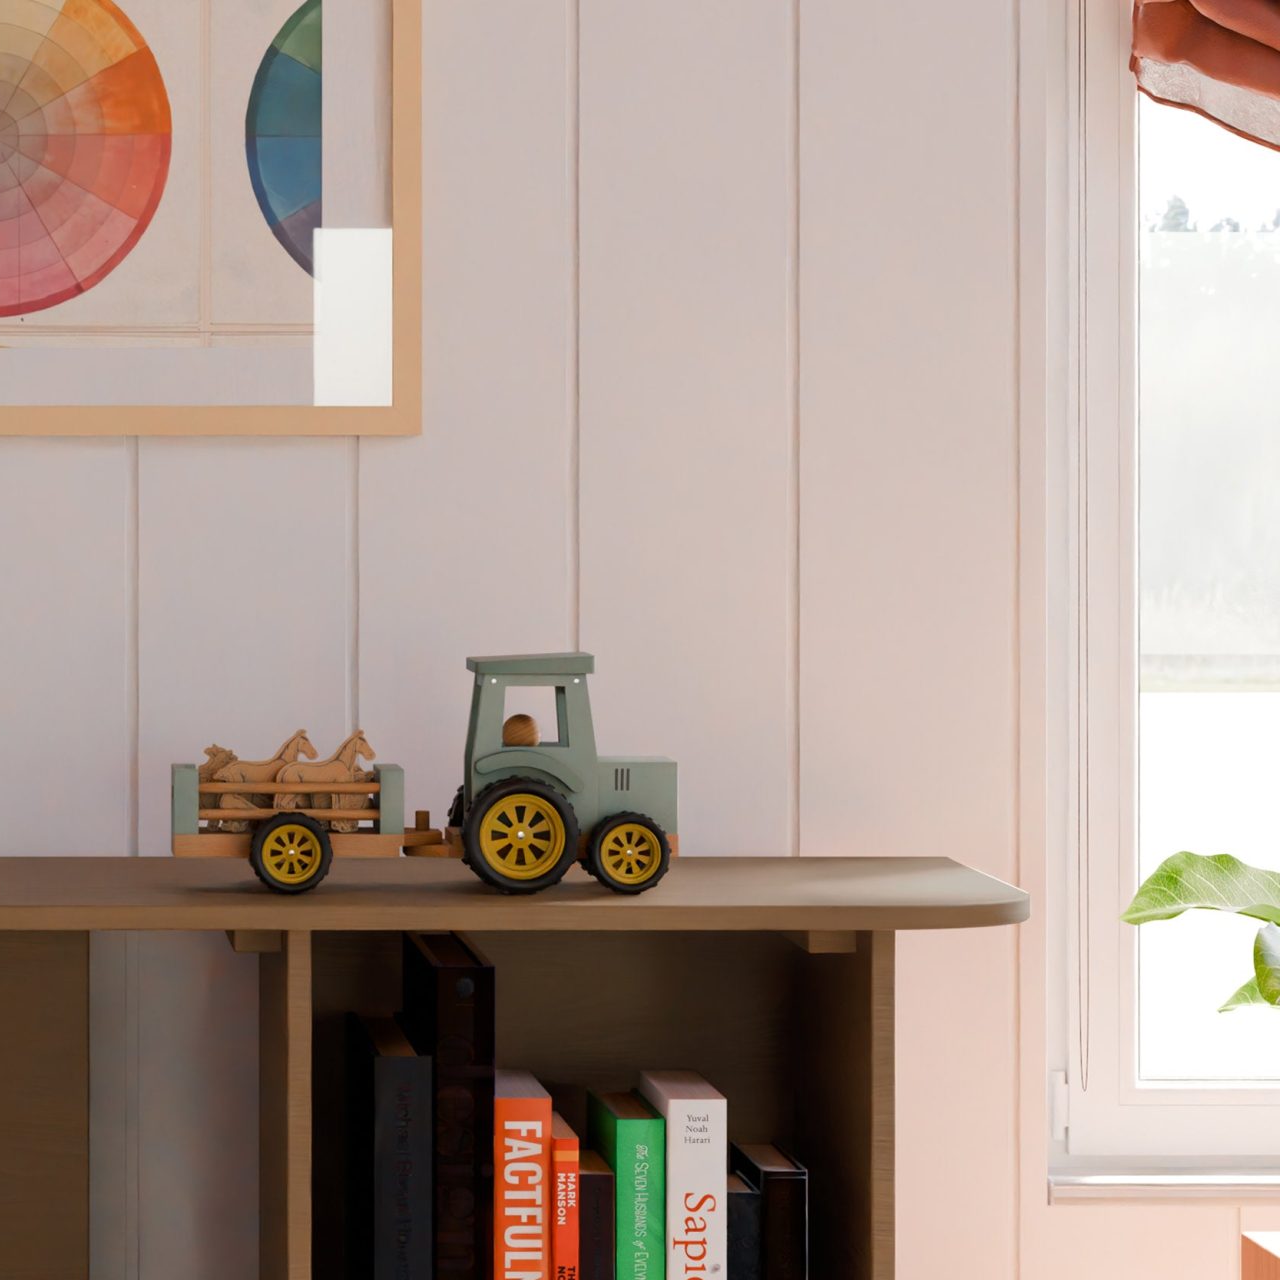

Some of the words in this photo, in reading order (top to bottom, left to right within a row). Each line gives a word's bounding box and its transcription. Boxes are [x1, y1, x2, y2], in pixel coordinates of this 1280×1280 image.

[685, 1125, 708, 1133] Noah
[686, 1114, 709, 1123] Yuval
[683, 1136, 711, 1144] Harari
[567, 1173, 576, 1207] MARK
[635, 1162, 649, 1191] SEVEN
[557, 1173, 566, 1226] MANSON
[634, 1192, 649, 1238] HUSBANDS
